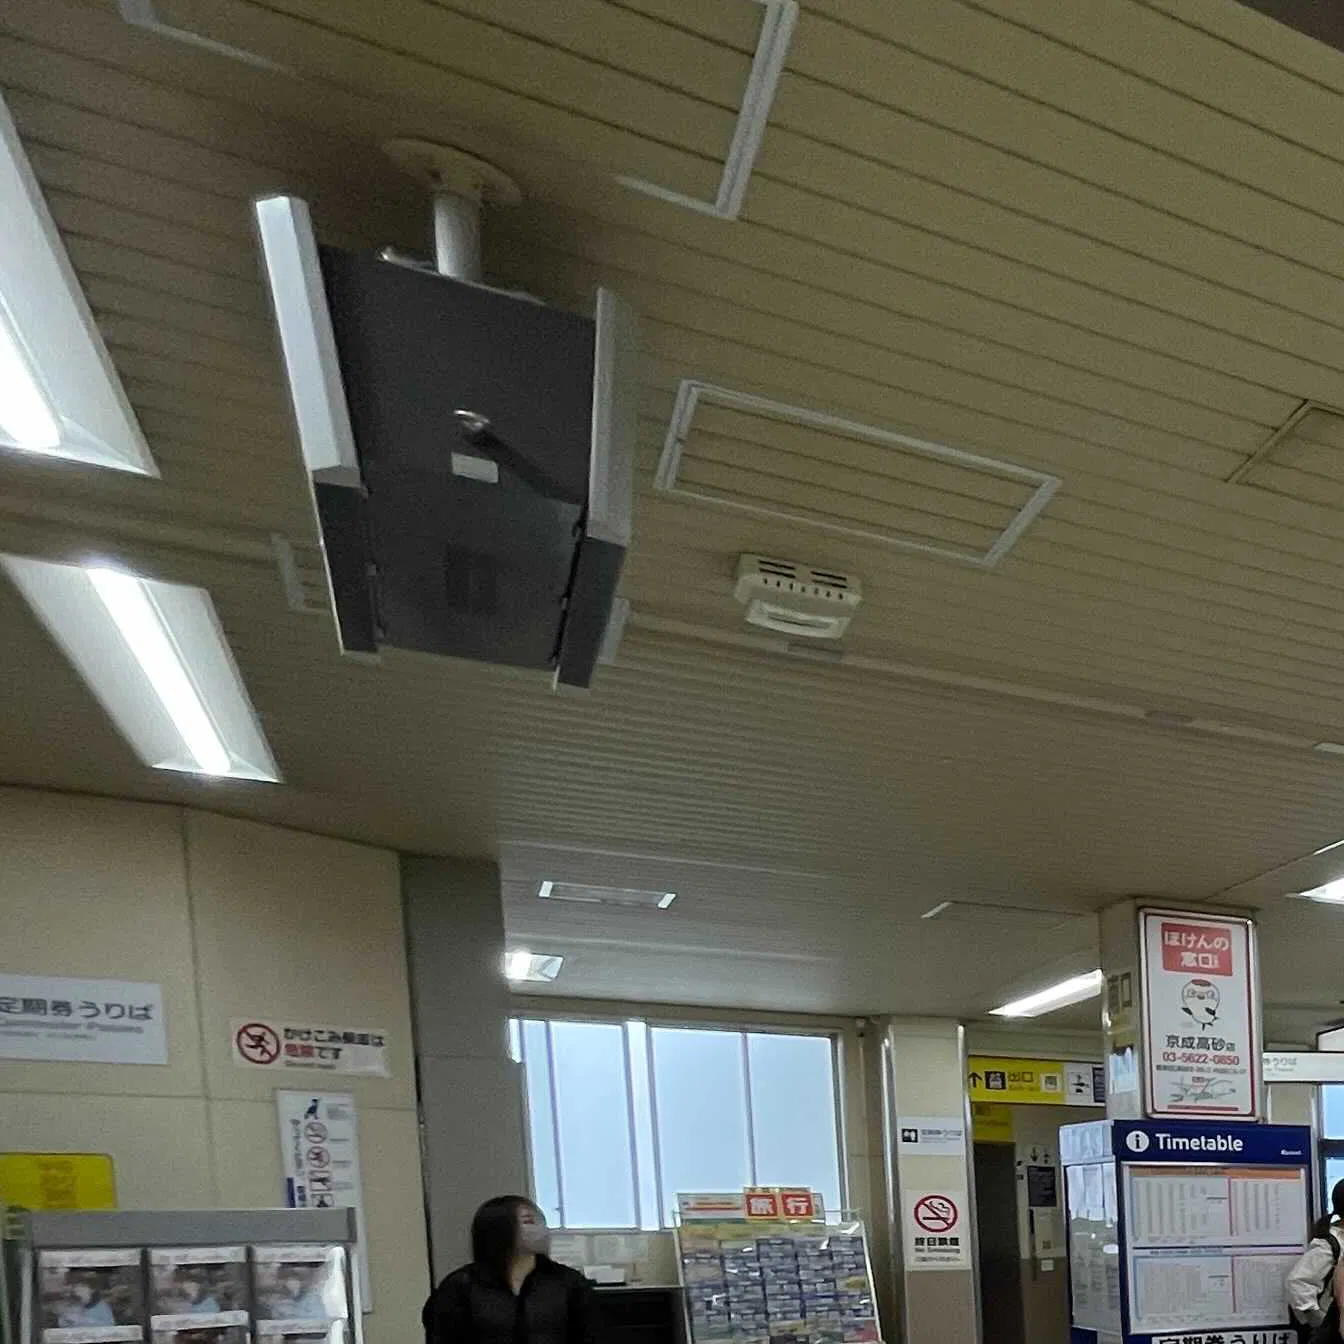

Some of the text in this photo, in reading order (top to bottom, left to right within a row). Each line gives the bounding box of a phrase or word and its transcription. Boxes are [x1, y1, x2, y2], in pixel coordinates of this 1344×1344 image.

[1163, 931, 1230, 951] ほけんの
[1180, 952, 1213, 969] 窓口
[1007, 1071, 1034, 1083] 出口
[1155, 1133, 1244, 1152] Timetable
[914, 1237, 960, 1247] 終日禁煙
